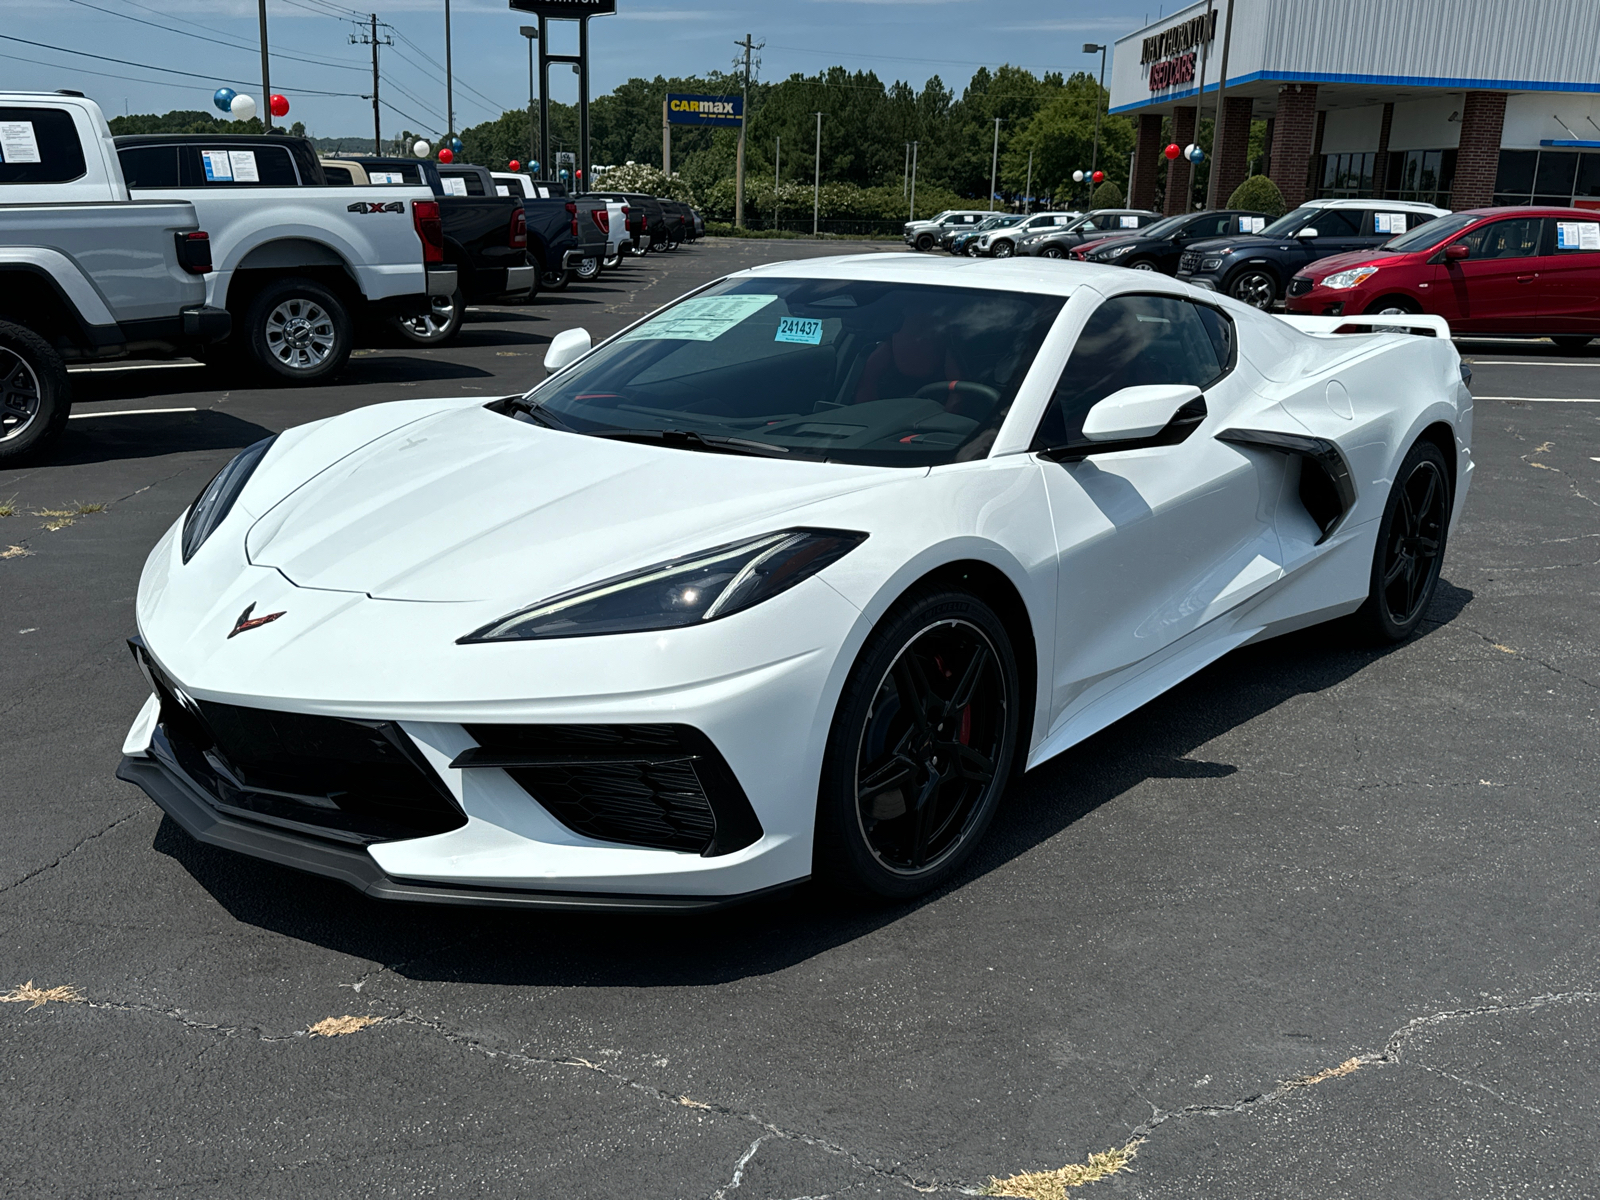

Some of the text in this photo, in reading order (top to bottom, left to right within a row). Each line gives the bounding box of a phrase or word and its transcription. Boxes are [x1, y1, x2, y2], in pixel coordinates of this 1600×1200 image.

[1149, 52, 1196, 91] USED CARS
[781, 319, 819, 336] 241437
